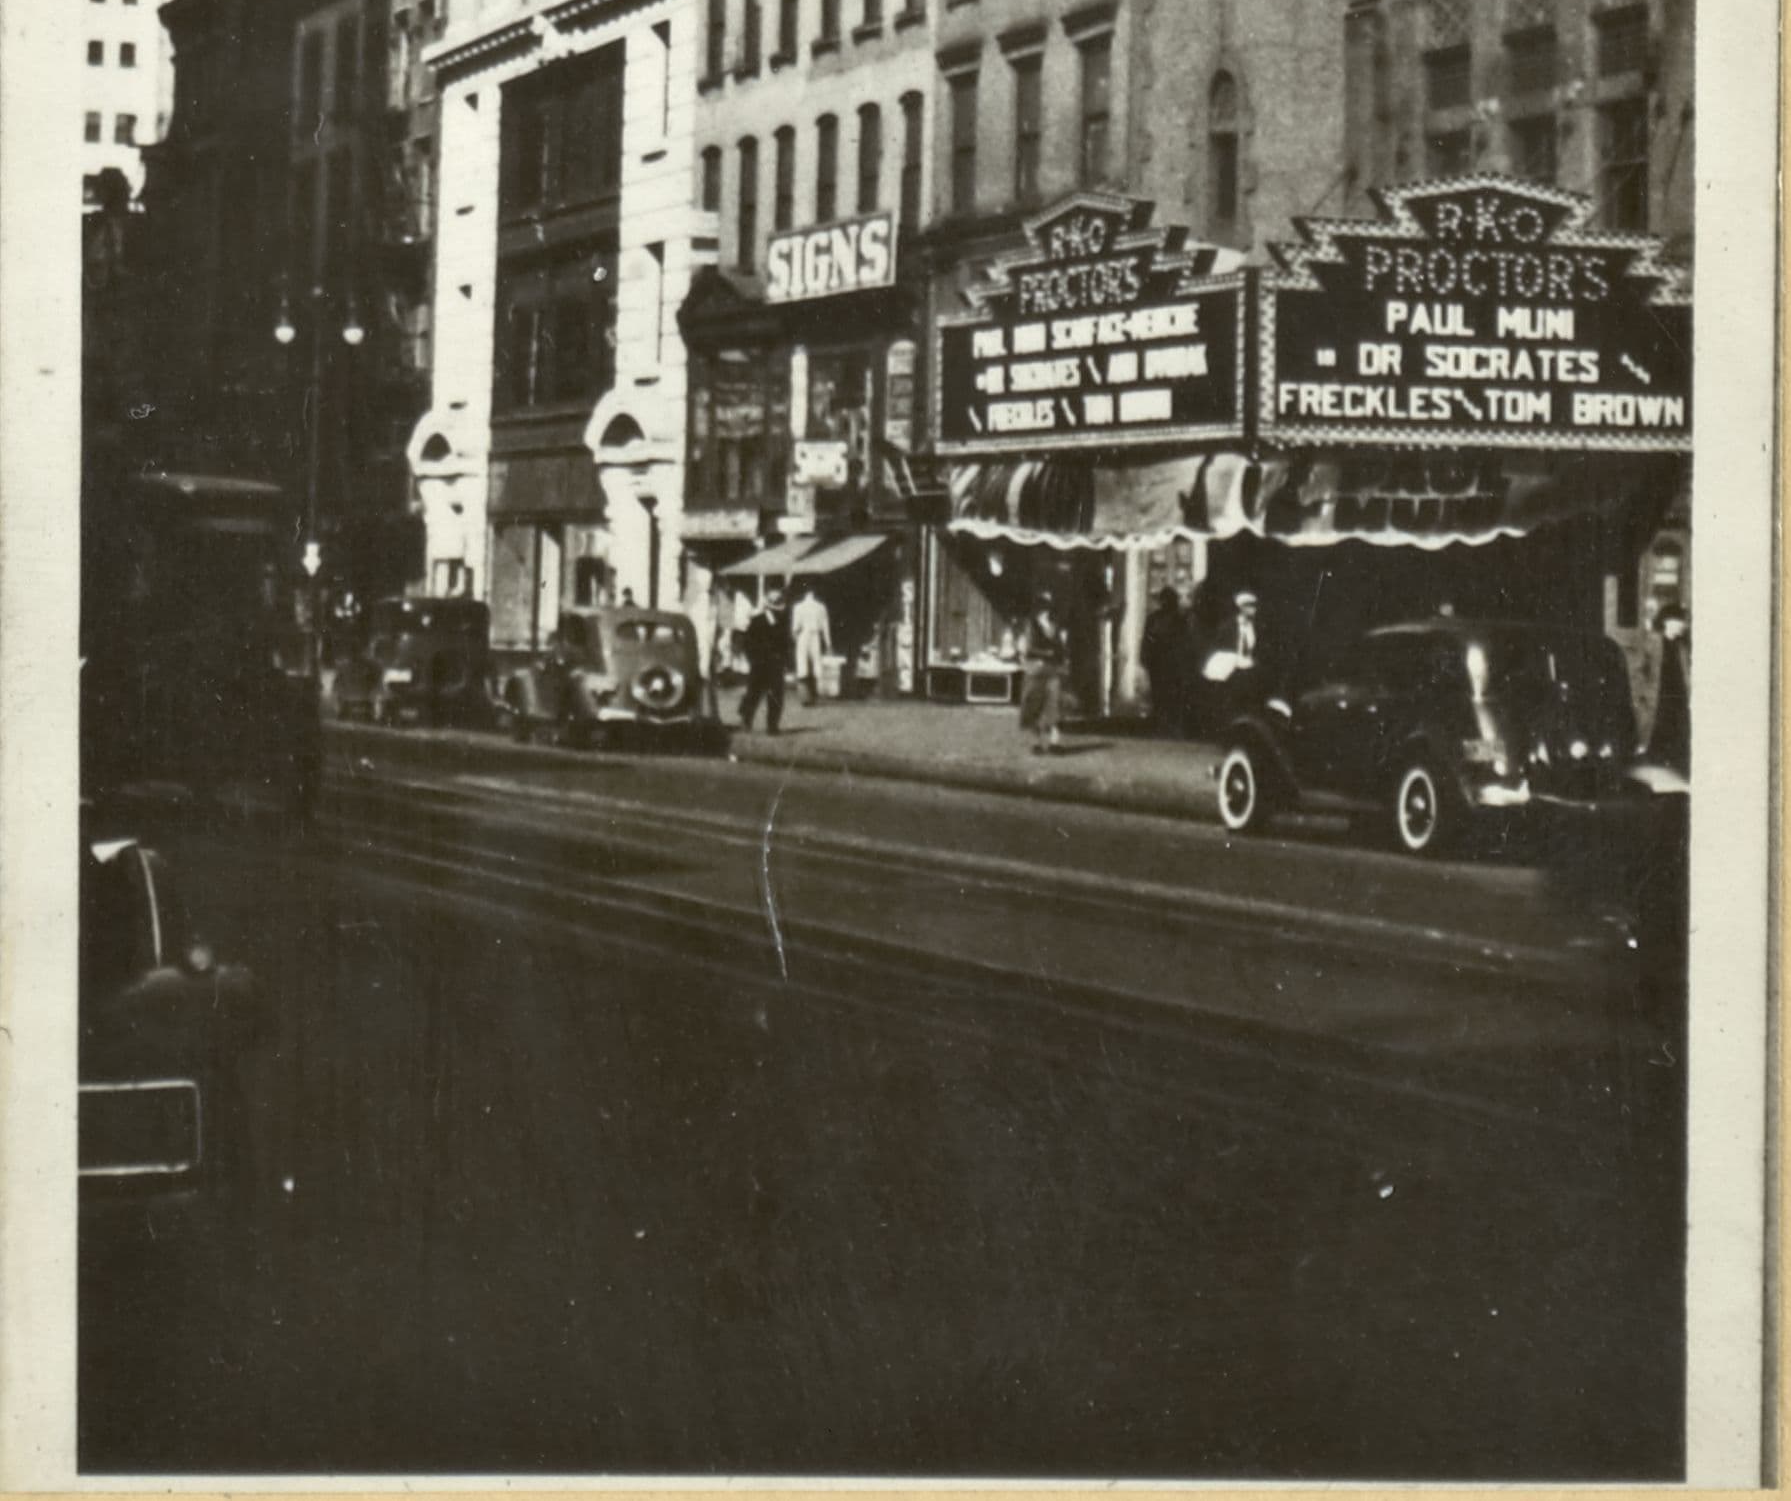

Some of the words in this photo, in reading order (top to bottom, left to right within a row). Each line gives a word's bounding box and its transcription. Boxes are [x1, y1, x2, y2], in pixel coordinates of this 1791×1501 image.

[766, 219, 889, 300] SIGNS
[1364, 245, 1609, 302] PROCTOR'S
[1387, 301, 1475, 336] PAUL
[1497, 307, 1575, 340] MUNI
[1358, 343, 1402, 376] DR
[1425, 345, 1599, 383] SOCRATES
[1278, 382, 1451, 420] FRECKLES
[1484, 388, 1551, 422] TOM
[1572, 392, 1684, 427] BROWN
